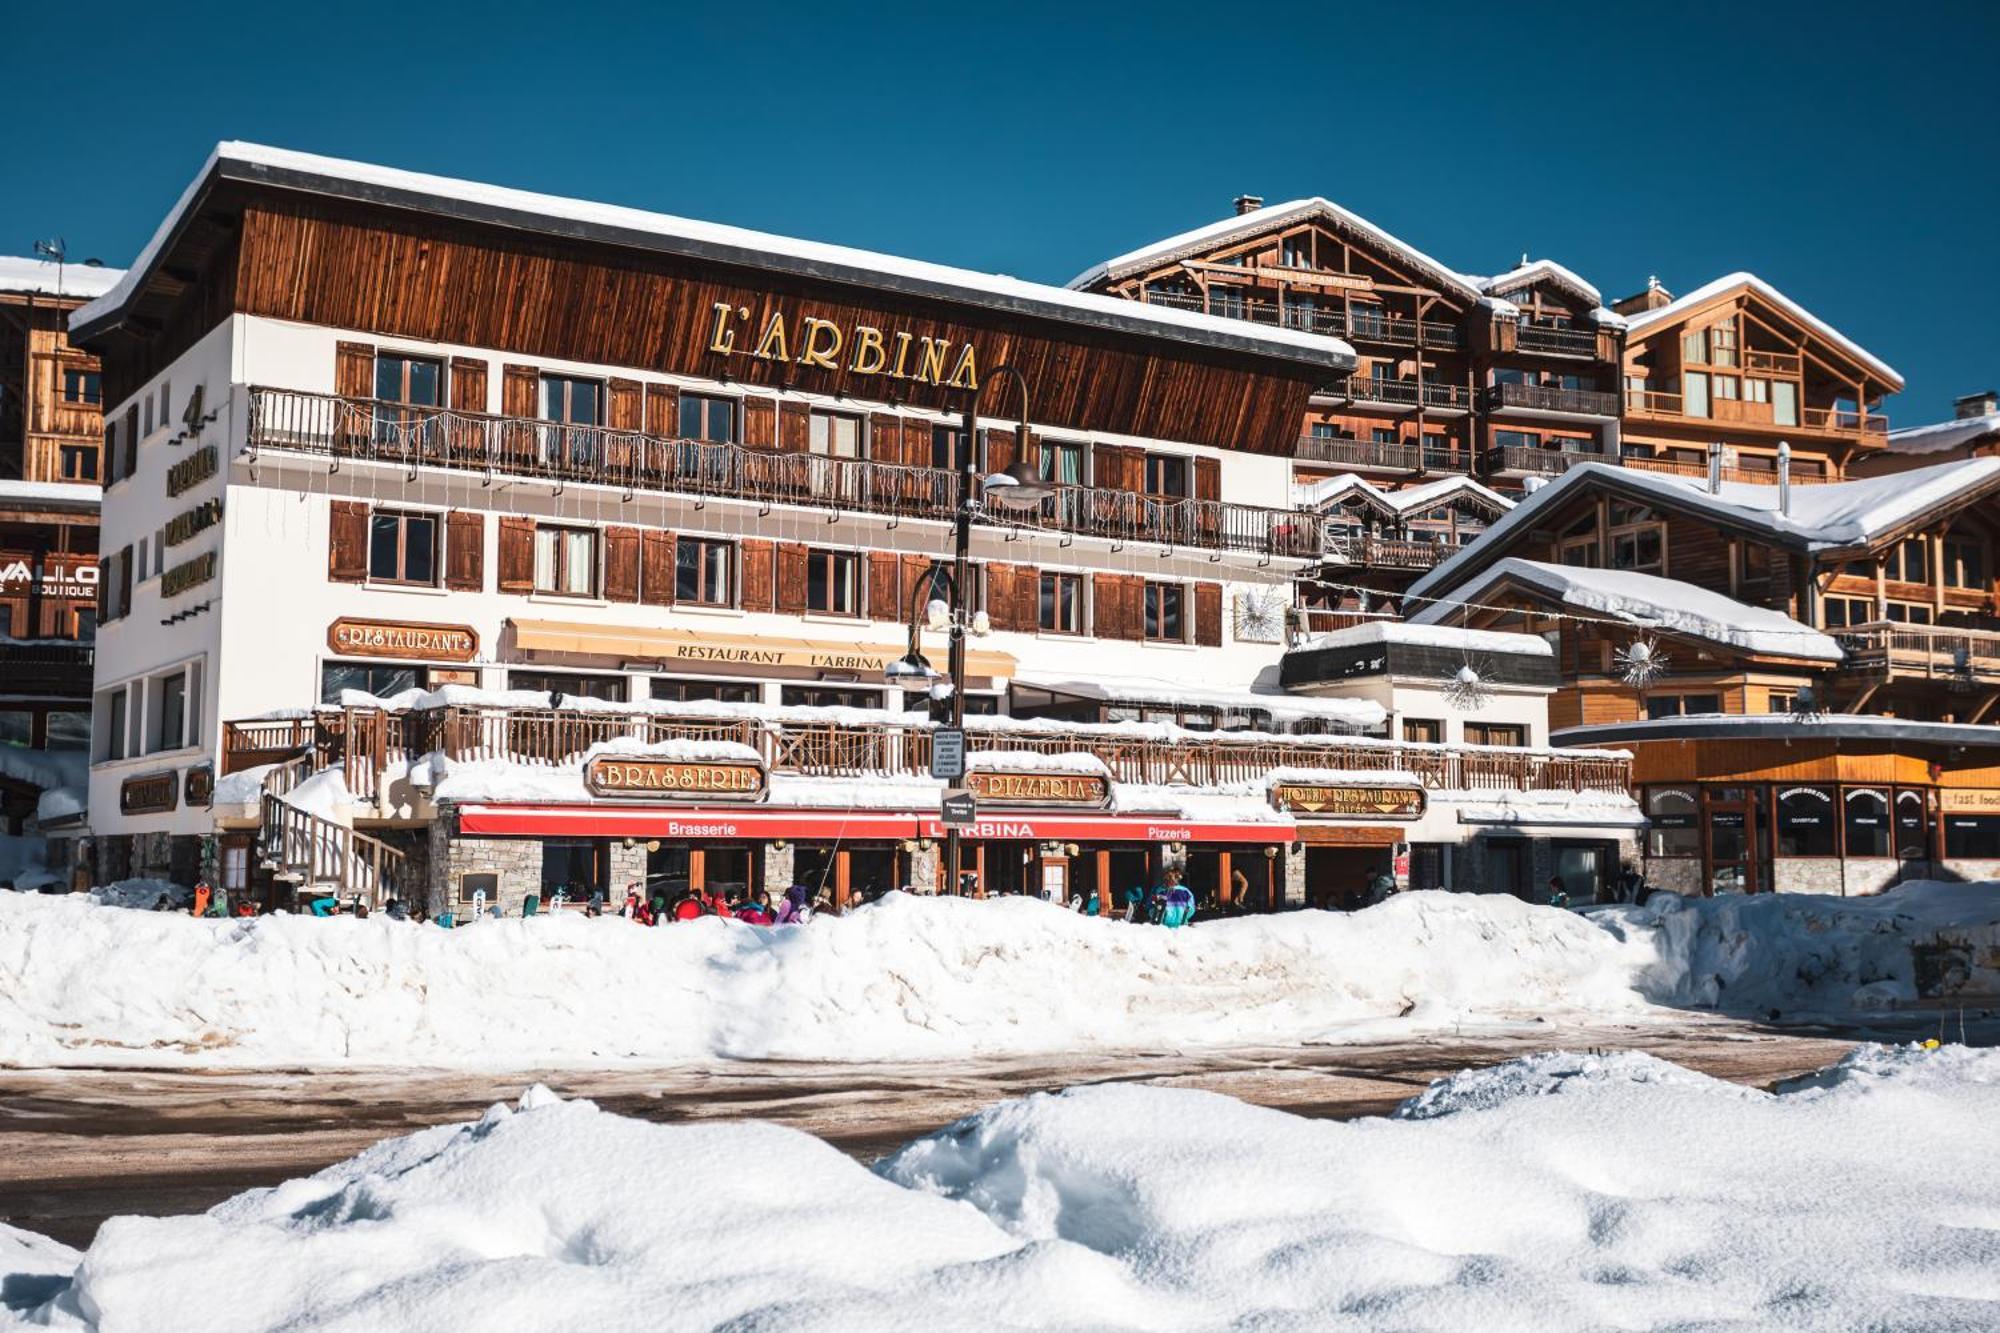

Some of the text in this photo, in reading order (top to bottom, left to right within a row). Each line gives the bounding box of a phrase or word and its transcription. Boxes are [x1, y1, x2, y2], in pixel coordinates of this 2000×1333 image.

[710, 303, 979, 390] L'ARBINA
[32, 584, 95, 596] BOUTIQUE
[349, 628, 461, 651] RESTAURANT
[677, 645, 884, 670] RESTAURANT L'ARBINA
[606, 765, 751, 790] BRASSERIE
[988, 777, 1086, 799] PIZZERIA
[1283, 788, 1414, 804] HOTEL RESTAURANT
[668, 822, 737, 836] Brasserie
[1148, 826, 1191, 840] Pizzeria
